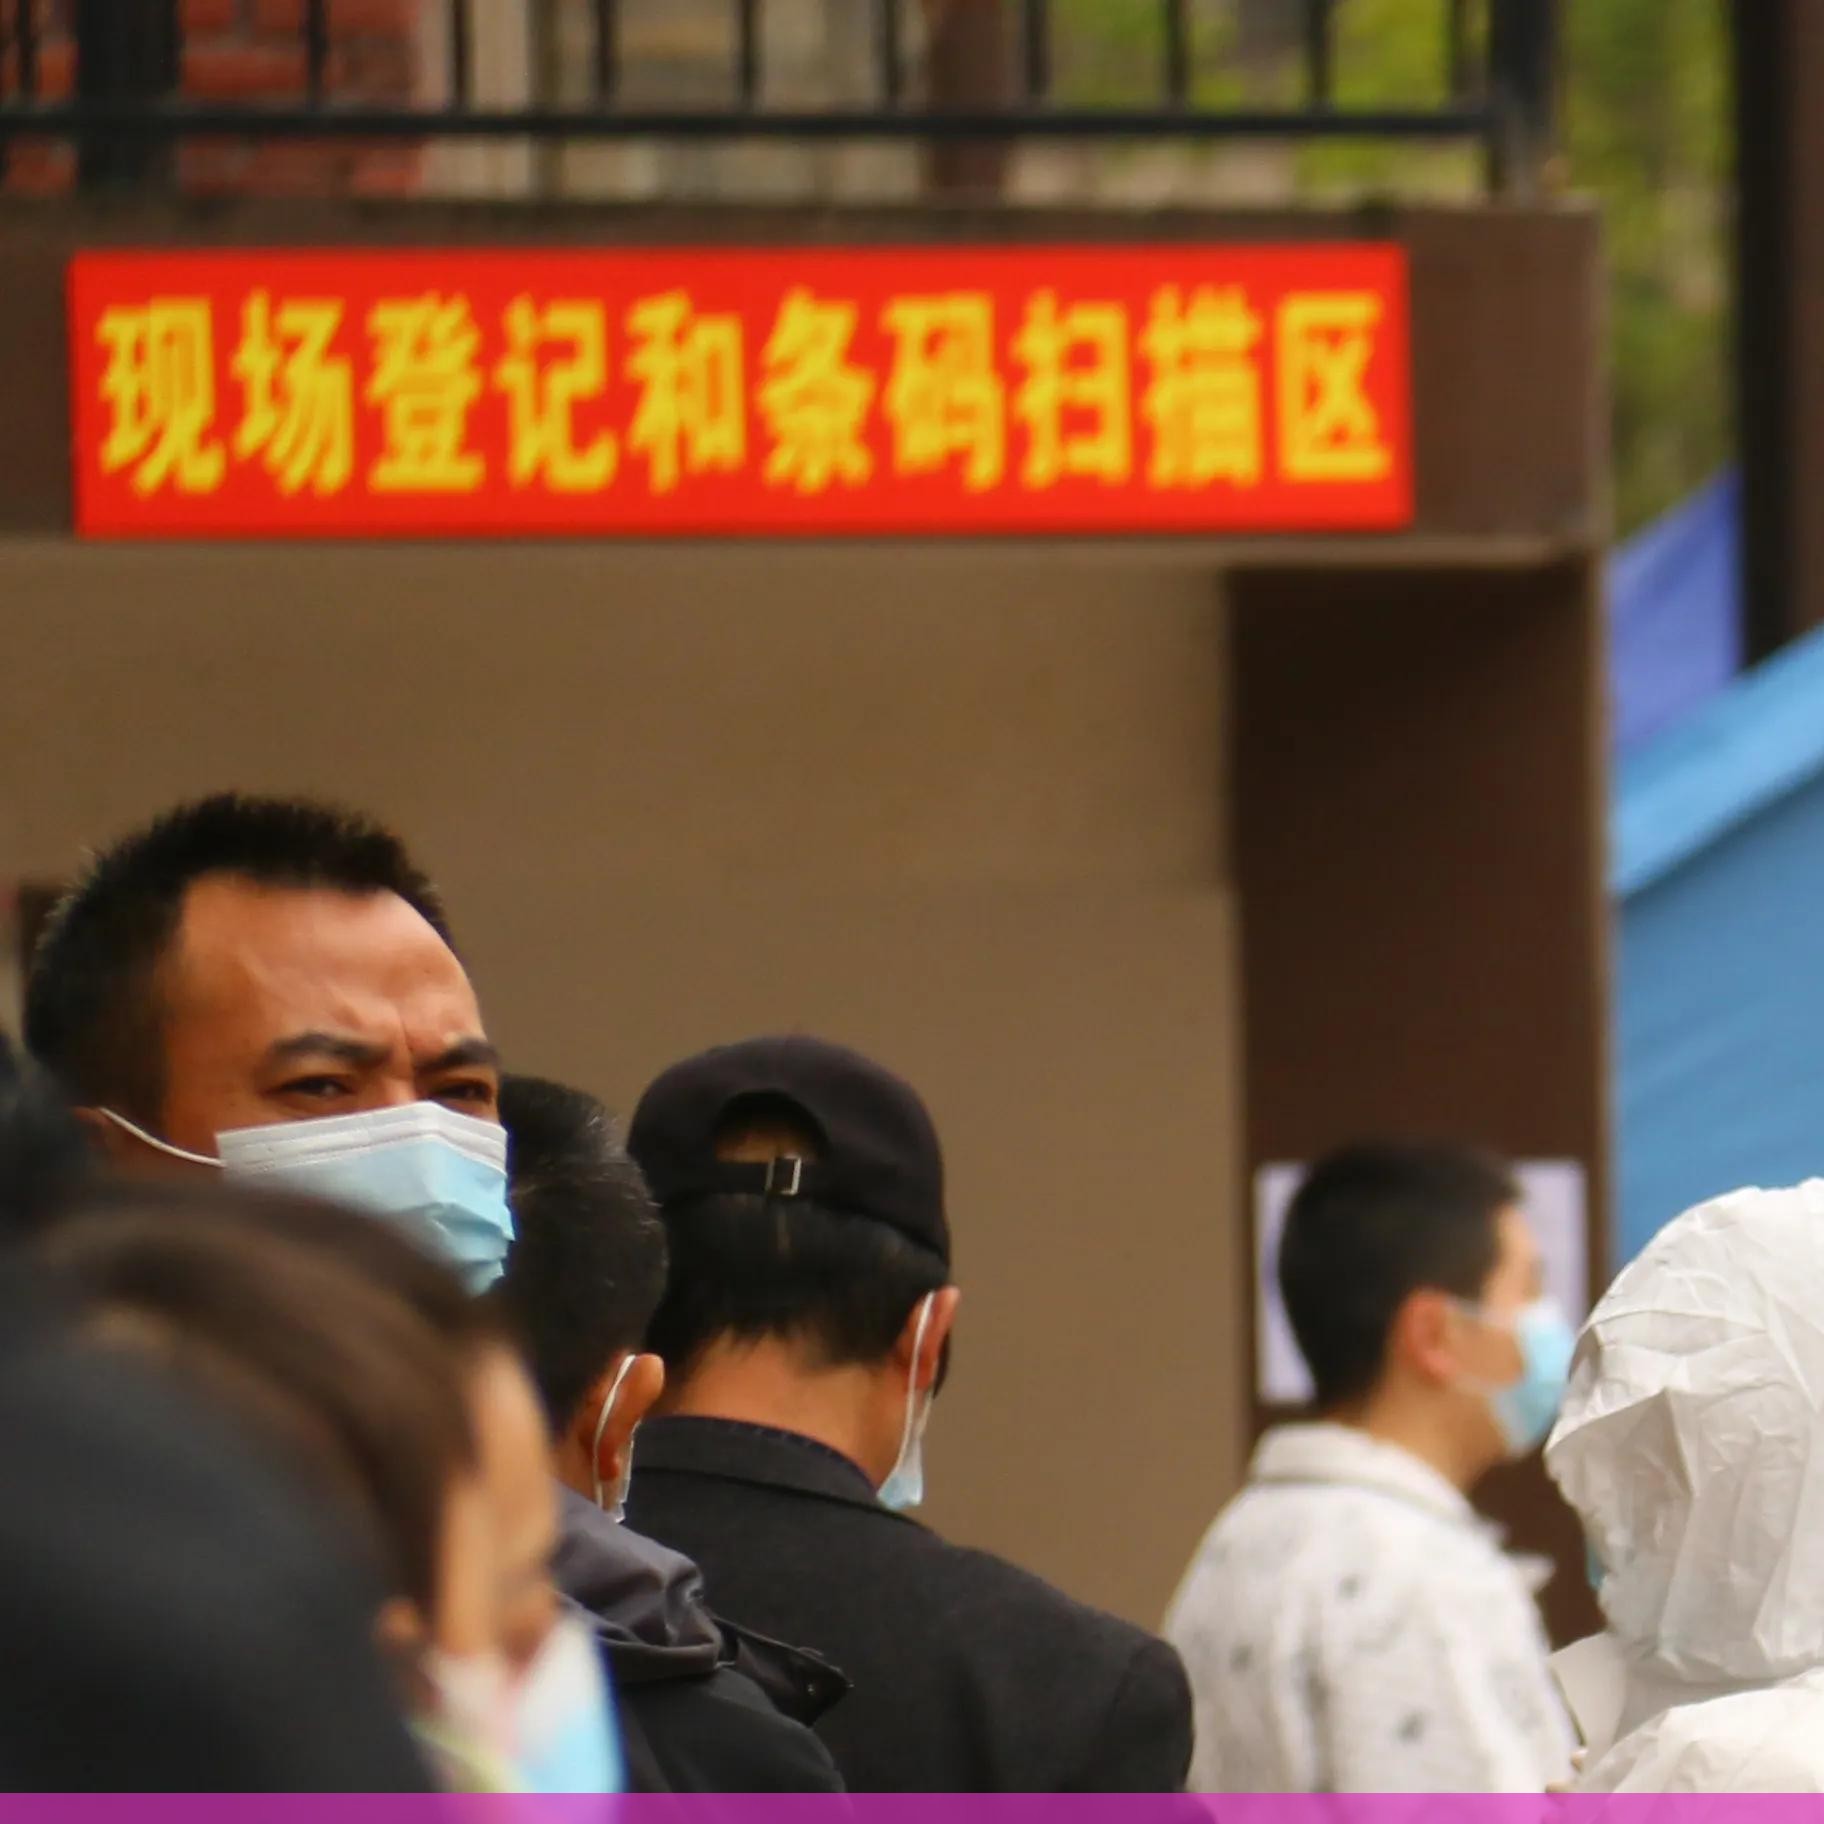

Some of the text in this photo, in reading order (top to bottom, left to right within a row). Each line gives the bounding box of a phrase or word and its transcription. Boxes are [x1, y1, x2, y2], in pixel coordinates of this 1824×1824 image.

[98, 285, 1392, 494] 现场登记和条码扫描区
